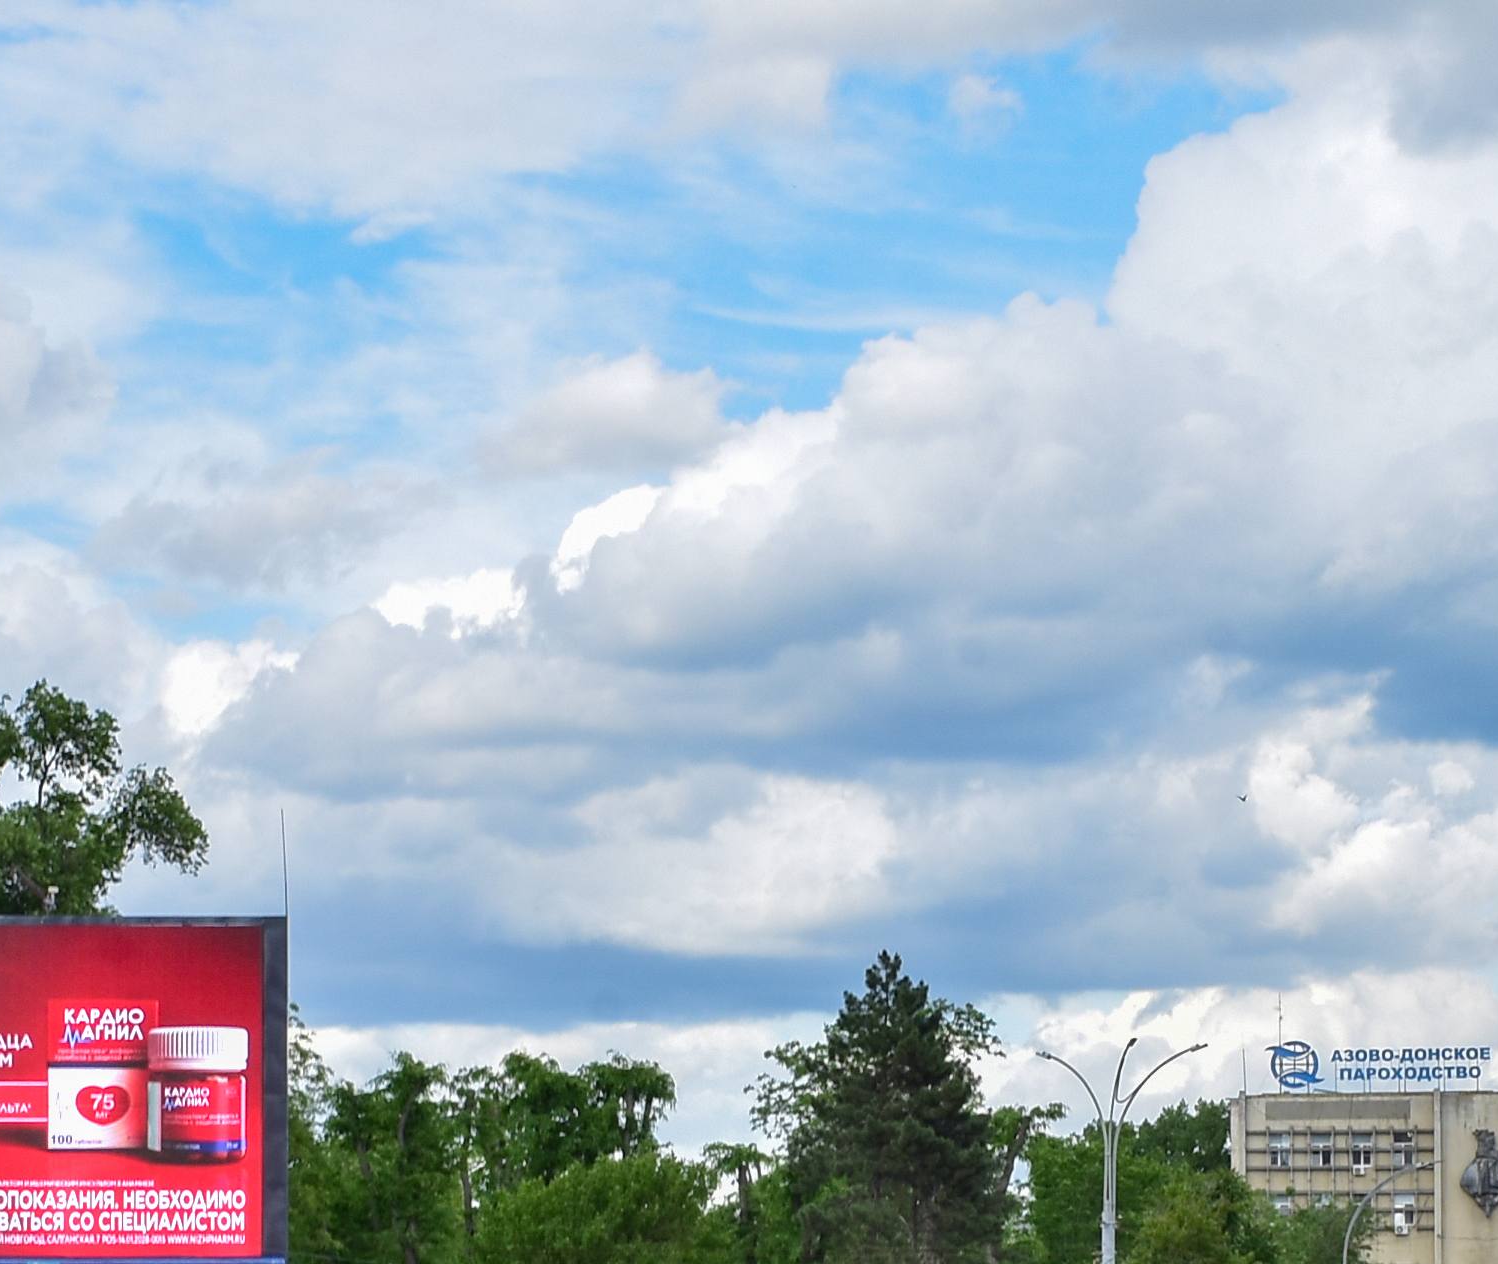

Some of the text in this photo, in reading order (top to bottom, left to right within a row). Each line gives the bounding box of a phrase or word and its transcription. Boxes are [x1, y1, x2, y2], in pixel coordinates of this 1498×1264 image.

[64, 1008, 145, 1026] КАРДИО
[1331, 1047, 1491, 1063] АЗОВО-ДОНСКОЕ
[1339, 1066, 1482, 1082] ПАРОХОДСТВО
[164, 1087, 210, 1098] КАРДИО
[90, 1093, 115, 1111] 75
[51, 1135, 73, 1145] 100
[123, 1189, 246, 1213] НЕОБХОДИМО
[68, 1211, 95, 1231] СО
[98, 1211, 245, 1234] СПЕЦИАЛИСТОМ
